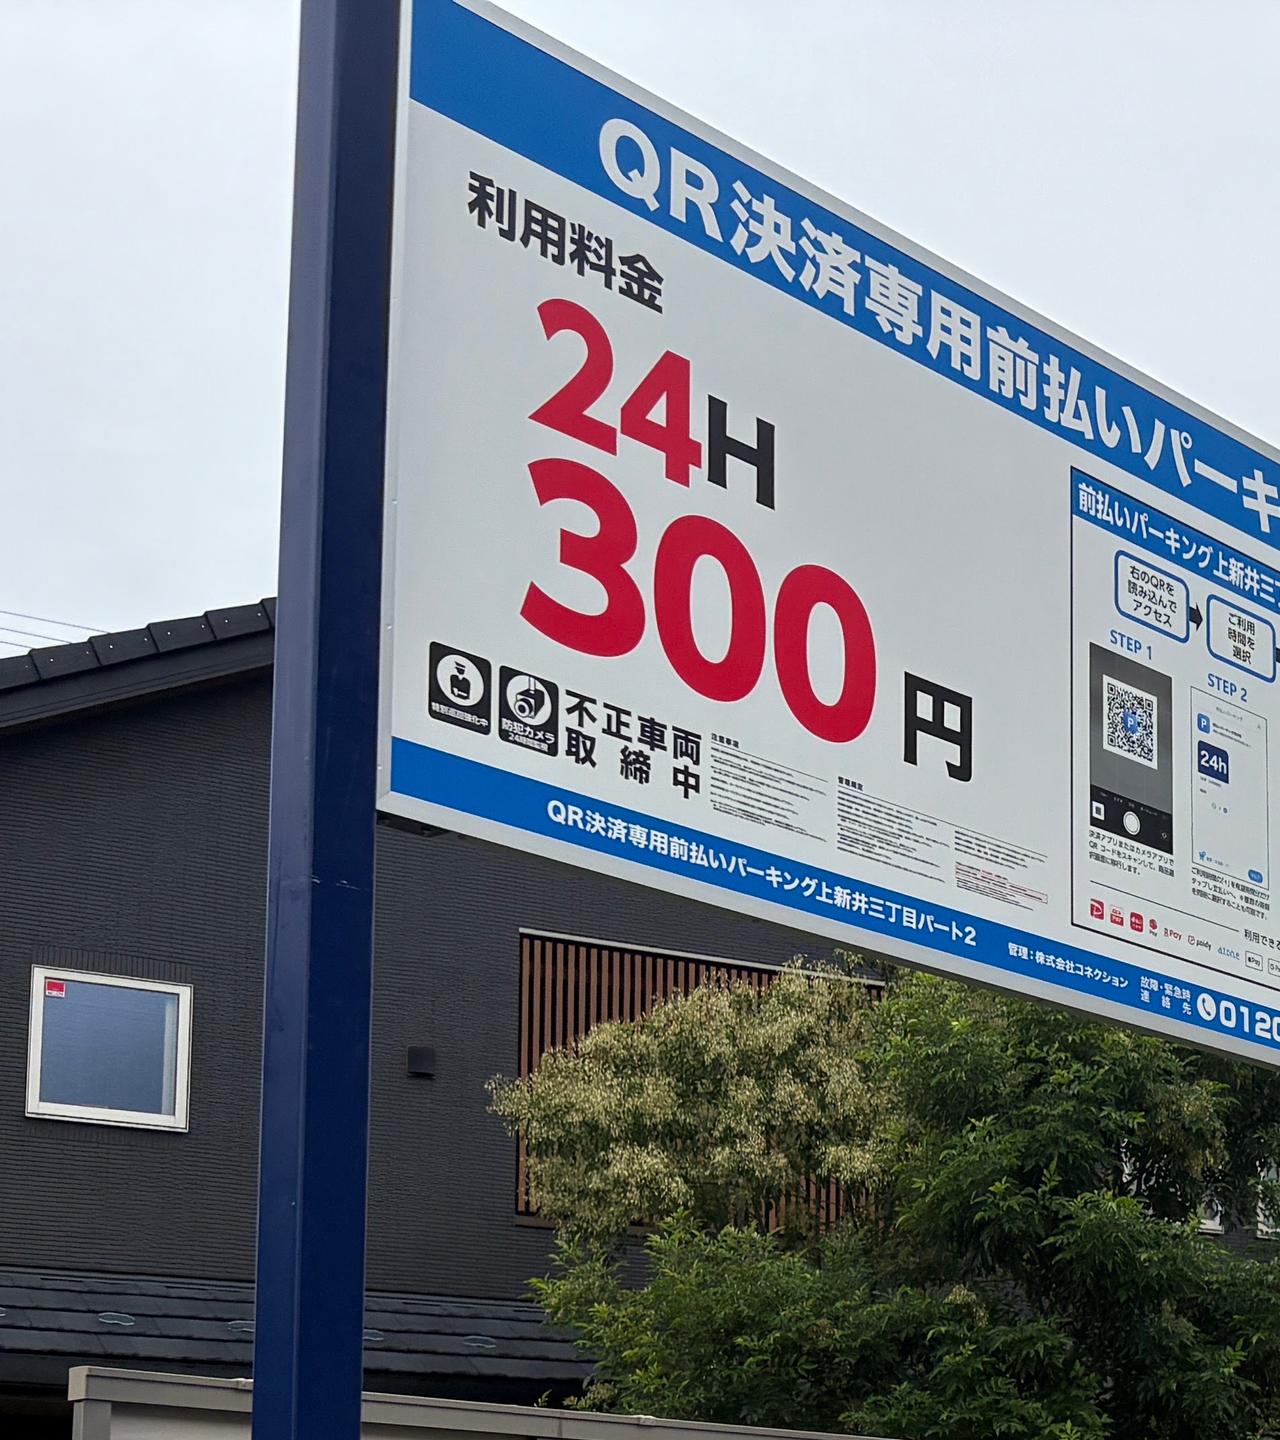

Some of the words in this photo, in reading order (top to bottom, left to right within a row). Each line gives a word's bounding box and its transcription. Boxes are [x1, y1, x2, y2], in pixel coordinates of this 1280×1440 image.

[466, 170, 664, 314] 利用料金
[527, 297, 775, 511] 24H
[1129, 565, 1175, 597] 右のQRを
[1127, 579, 1178, 614] 読み込んで
[1132, 598, 1173, 628] アクセス
[1227, 612, 1256, 637] ご利用
[1110, 629, 1142, 654] STEP
[1146, 645, 1152, 660] 1
[1227, 628, 1256, 650] 時間を
[1232, 646, 1252, 665] 選択
[1207, 673, 1237, 696] STEP
[1240, 687, 1248, 702] 2
[501, 718, 555, 744] 防犯カメラ
[565, 689, 702, 766] 不正車両
[1200, 750, 1228, 775] 24h
[547, 799, 977, 946] QR決済専用前払いパーキング上新井三丁目パート2
